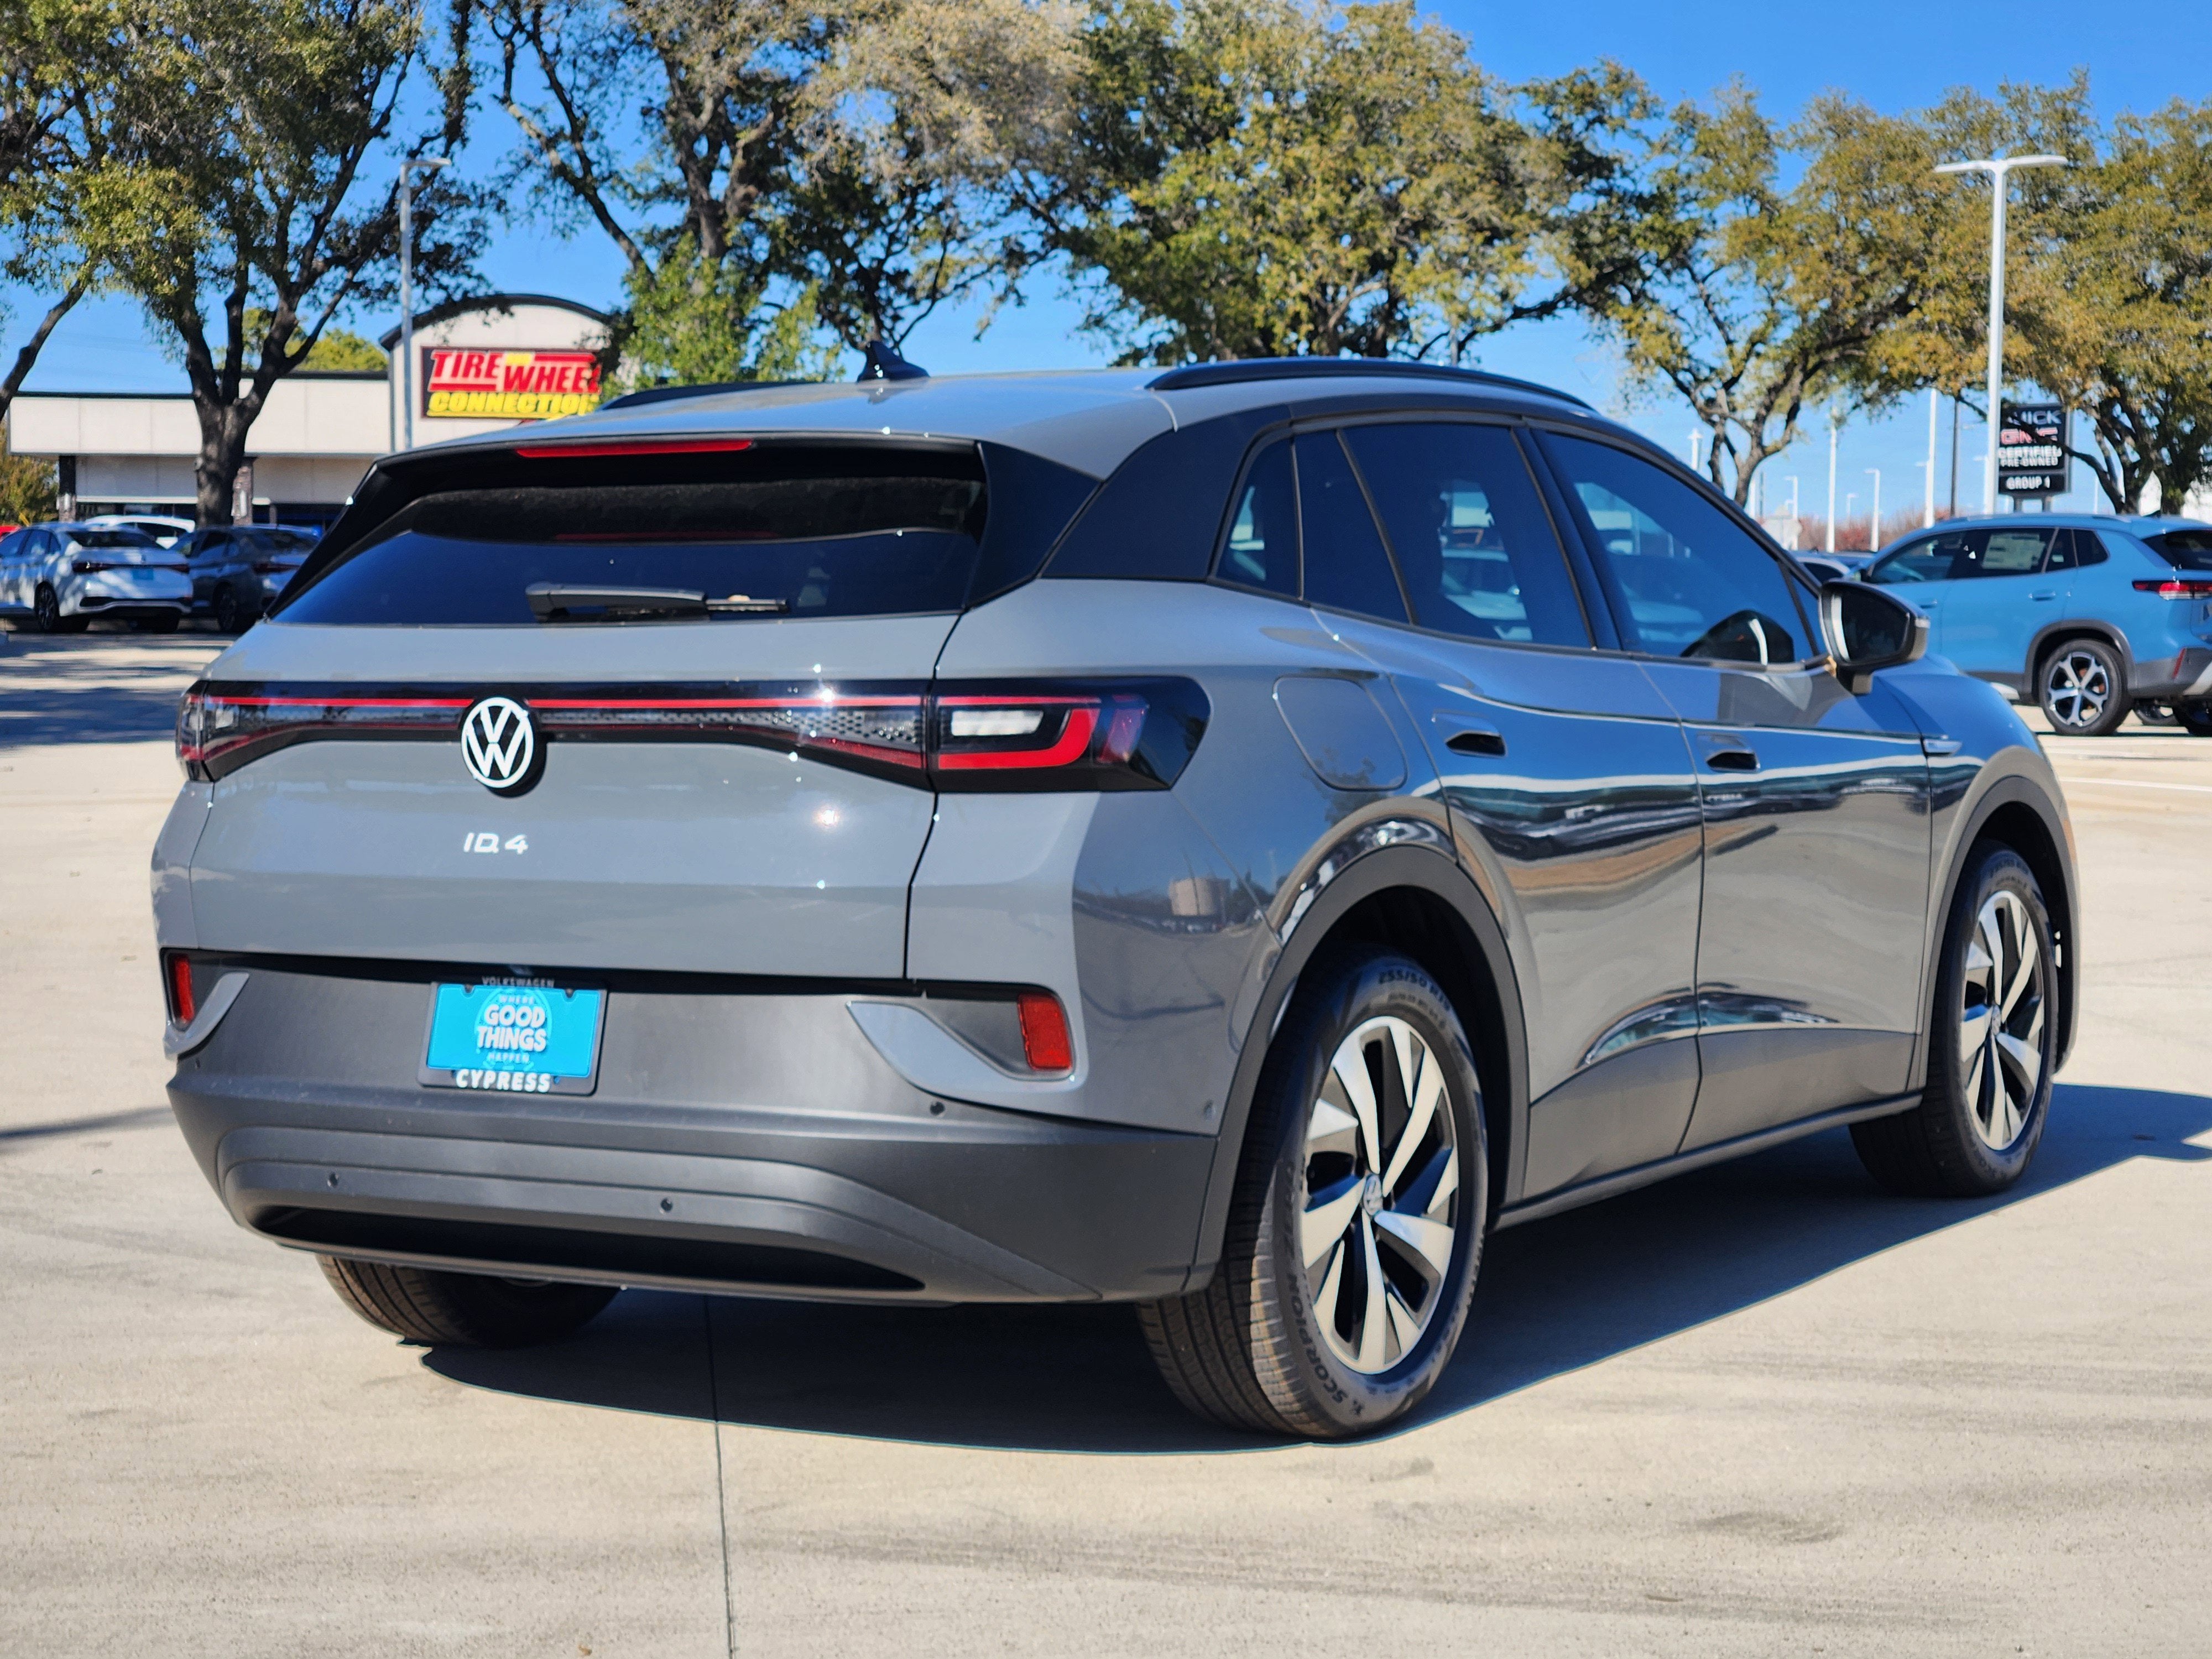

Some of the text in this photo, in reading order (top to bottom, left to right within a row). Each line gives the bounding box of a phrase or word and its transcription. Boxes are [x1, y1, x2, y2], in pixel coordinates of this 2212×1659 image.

[431, 351, 504, 379] TIRE
[2000, 456, 2058, 467] PRE-OWNED
[2006, 476, 2051, 490] GROUP 1
[484, 1004, 546, 1028] GOOD
[477, 1026, 547, 1052] THINGS
[456, 1068, 551, 1093] CYPRESS
[1286, 1272, 1348, 1404] SCORPION
